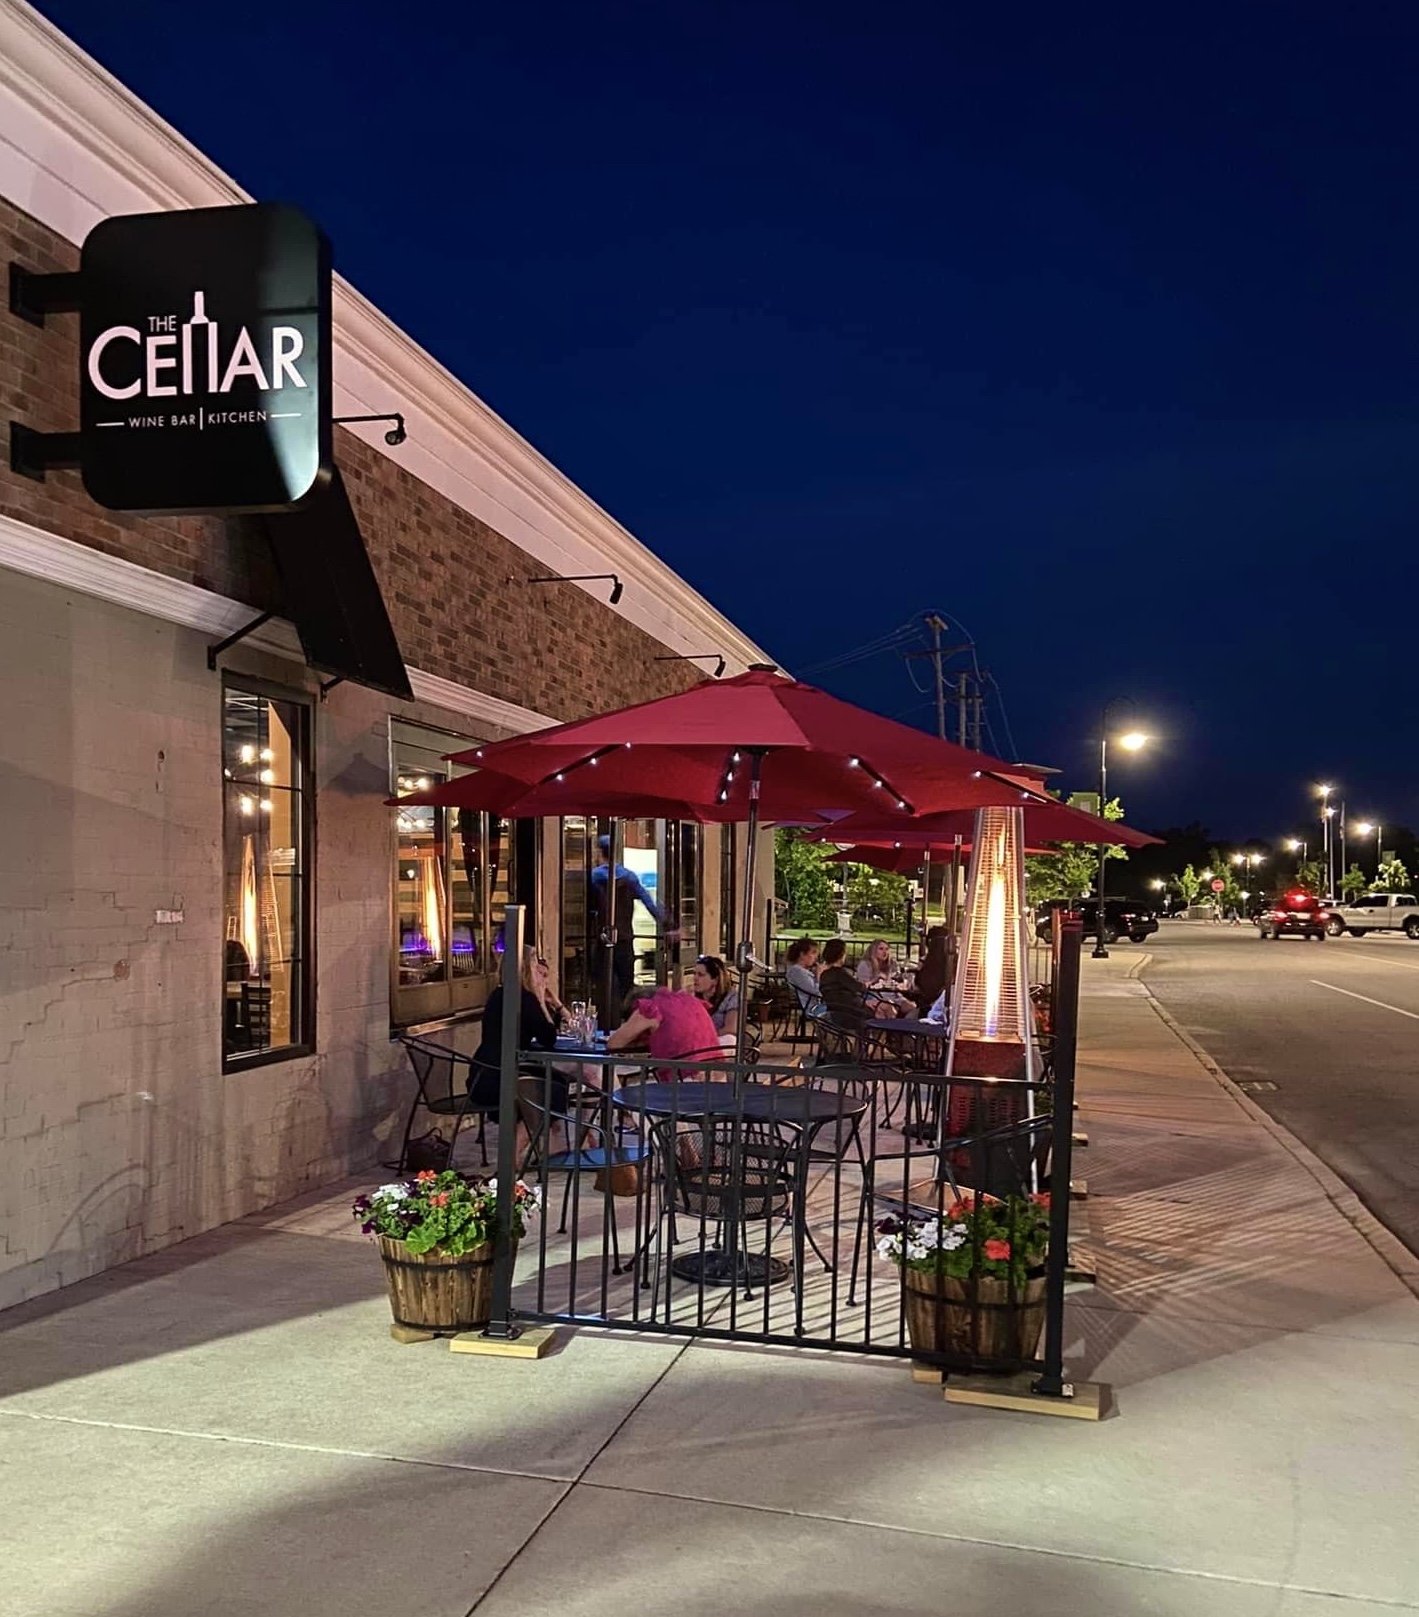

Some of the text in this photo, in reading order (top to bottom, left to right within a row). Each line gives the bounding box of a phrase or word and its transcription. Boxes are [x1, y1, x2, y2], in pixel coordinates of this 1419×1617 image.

[148, 315, 177, 332] THE
[128, 410, 267, 428] WINE BAR KITCHEN
